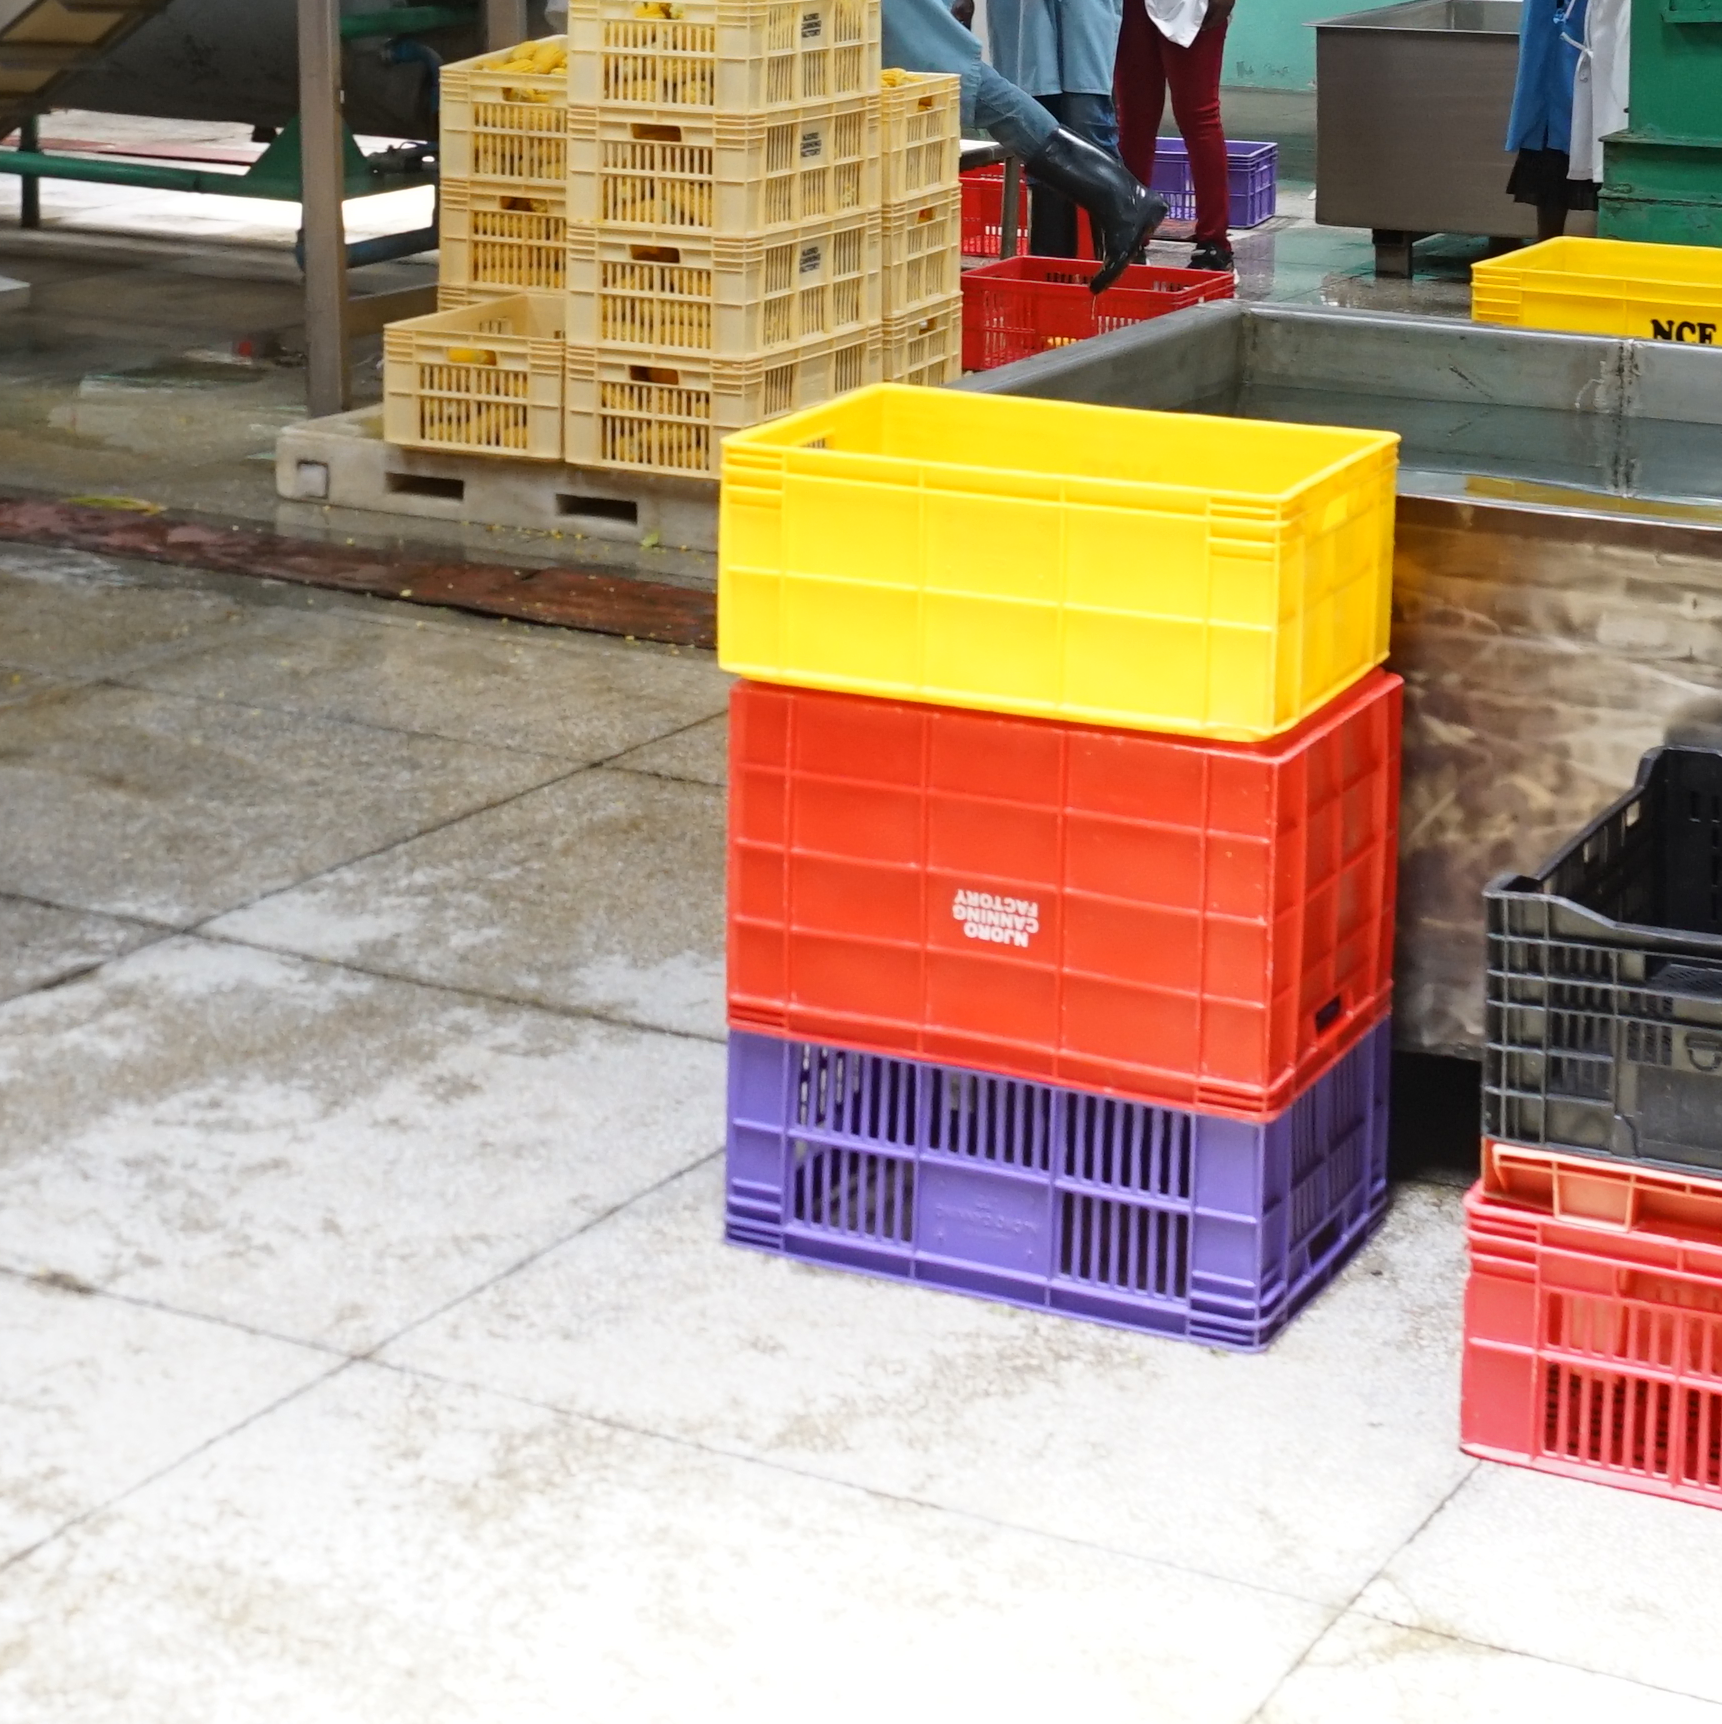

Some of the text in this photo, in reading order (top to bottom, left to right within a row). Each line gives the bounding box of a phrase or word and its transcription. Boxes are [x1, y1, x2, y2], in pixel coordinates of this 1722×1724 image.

[954, 888, 1039, 917] FACTORY
[952, 904, 1039, 934] CANNING
[963, 921, 1029, 948] NJORO
